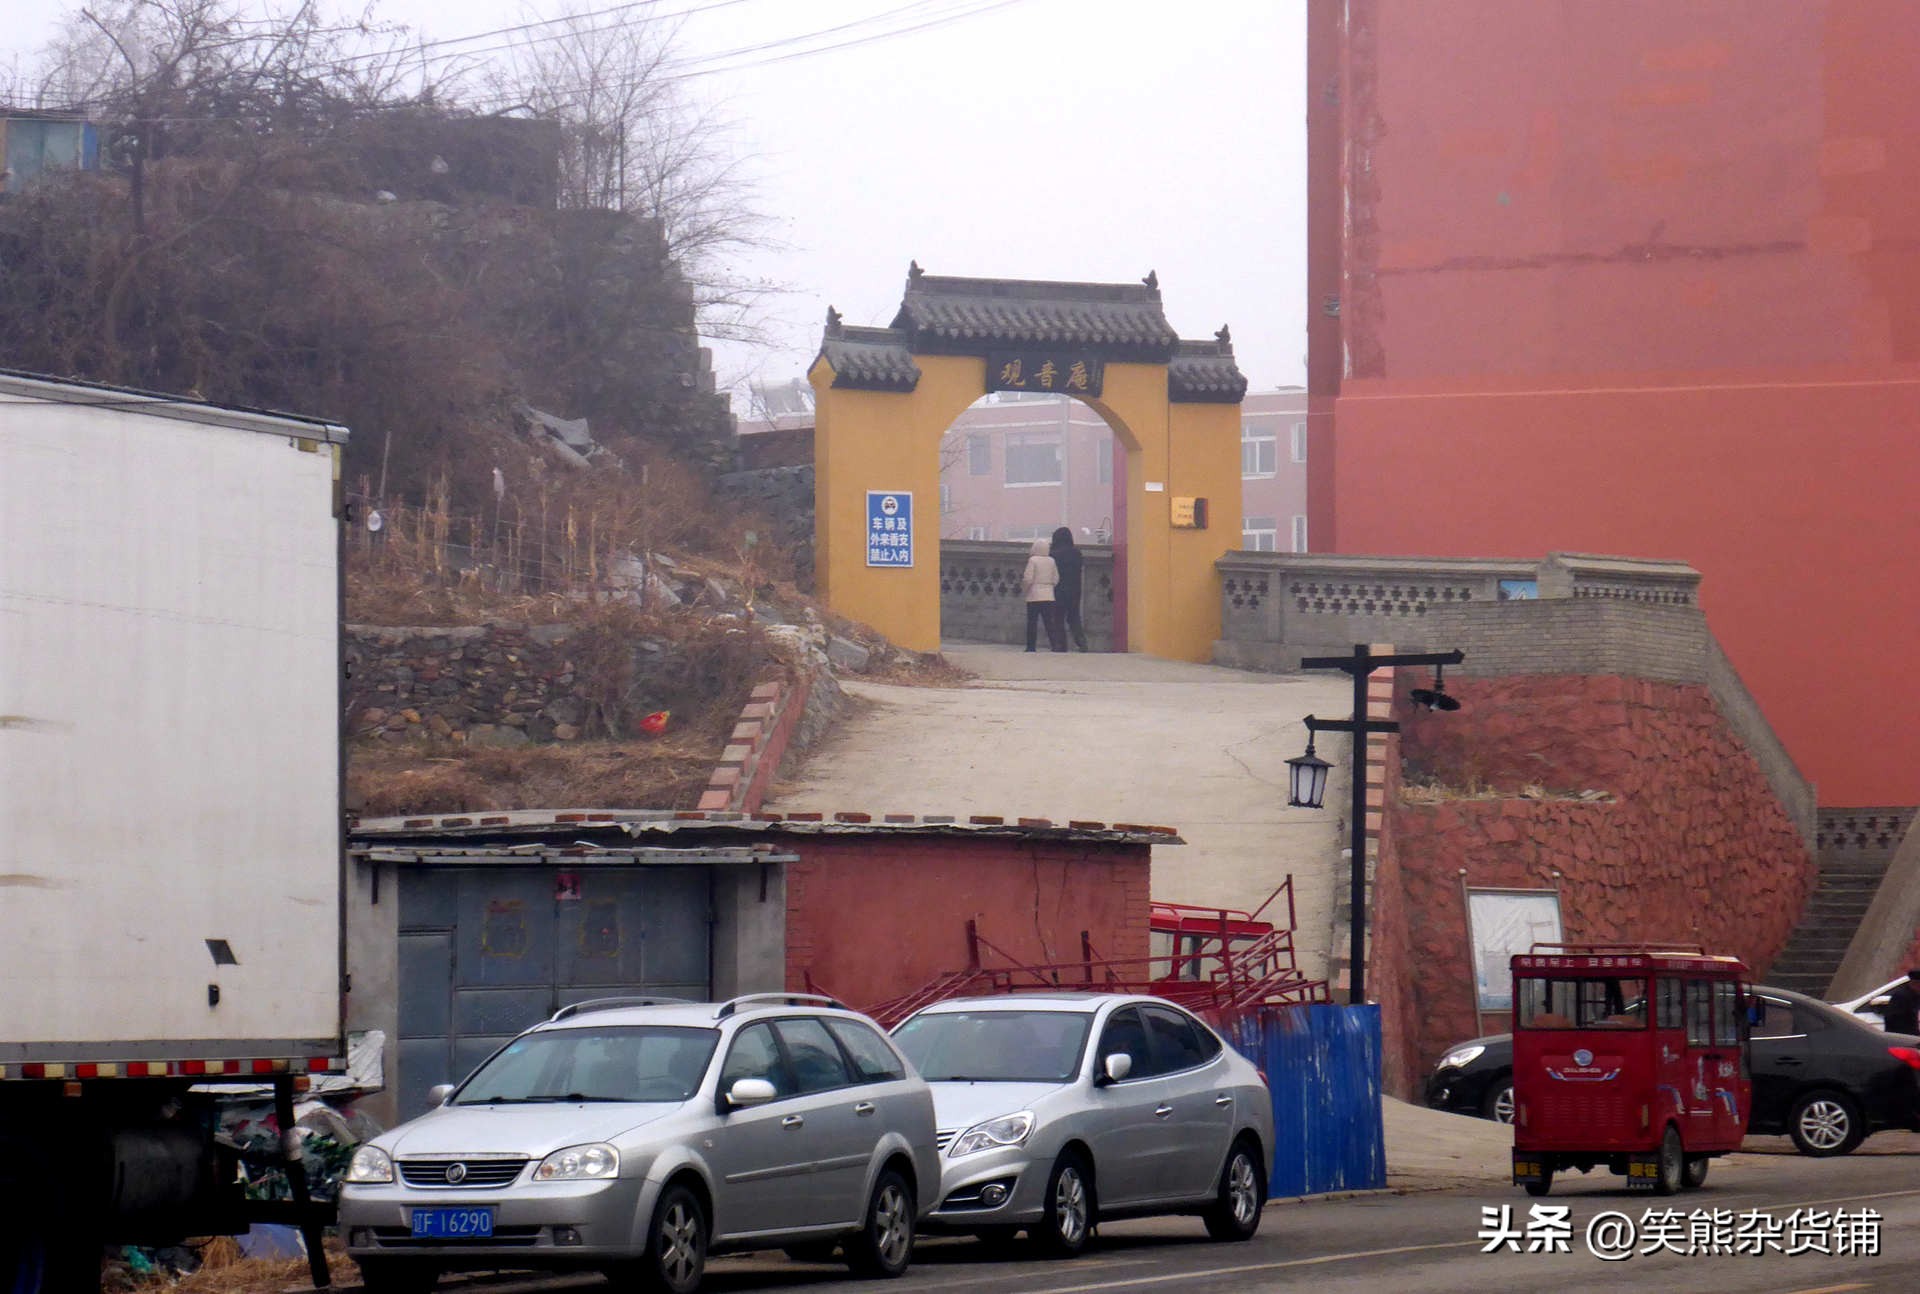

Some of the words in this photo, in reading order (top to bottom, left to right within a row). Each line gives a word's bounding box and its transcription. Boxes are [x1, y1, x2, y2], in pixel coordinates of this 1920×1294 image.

[872, 517, 907, 530] 车辆及
[870, 548, 909, 562] 禁止入内
